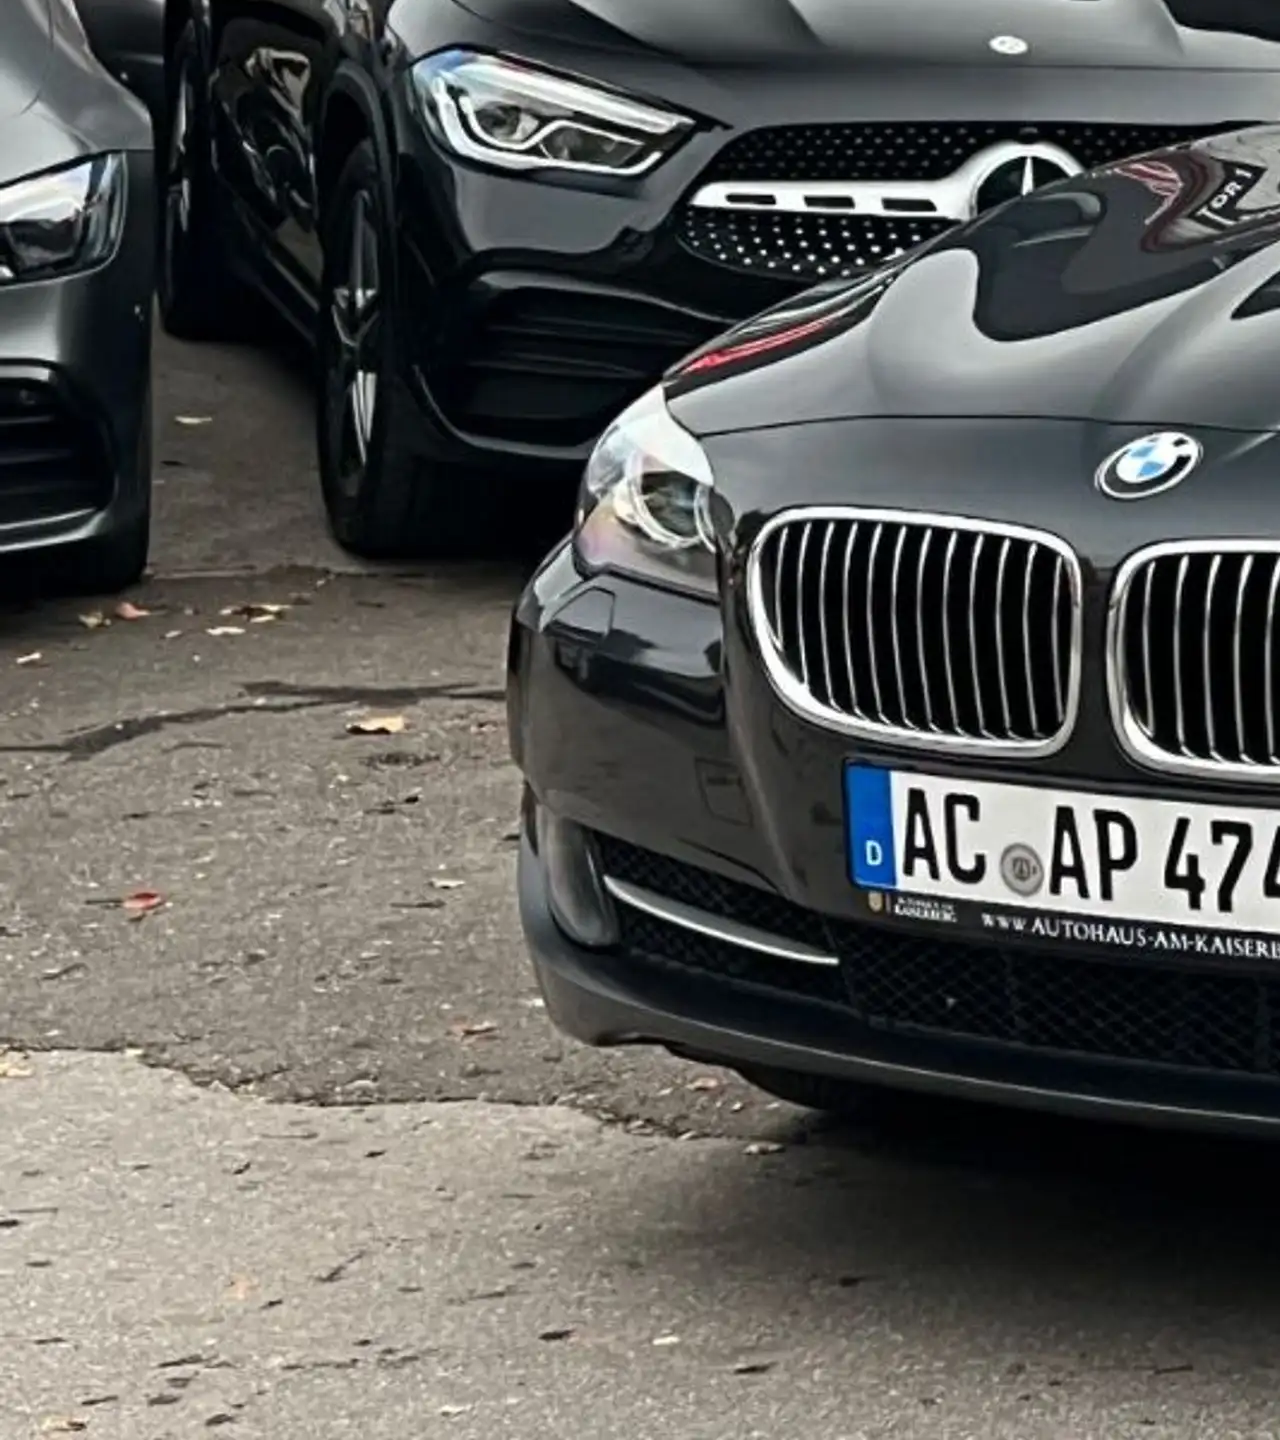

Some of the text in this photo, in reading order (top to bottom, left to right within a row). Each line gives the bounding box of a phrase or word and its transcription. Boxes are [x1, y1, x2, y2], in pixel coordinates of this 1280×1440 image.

[866, 840, 882, 865] D
[903, 788, 986, 884] AC
[1049, 805, 1138, 901] AP
